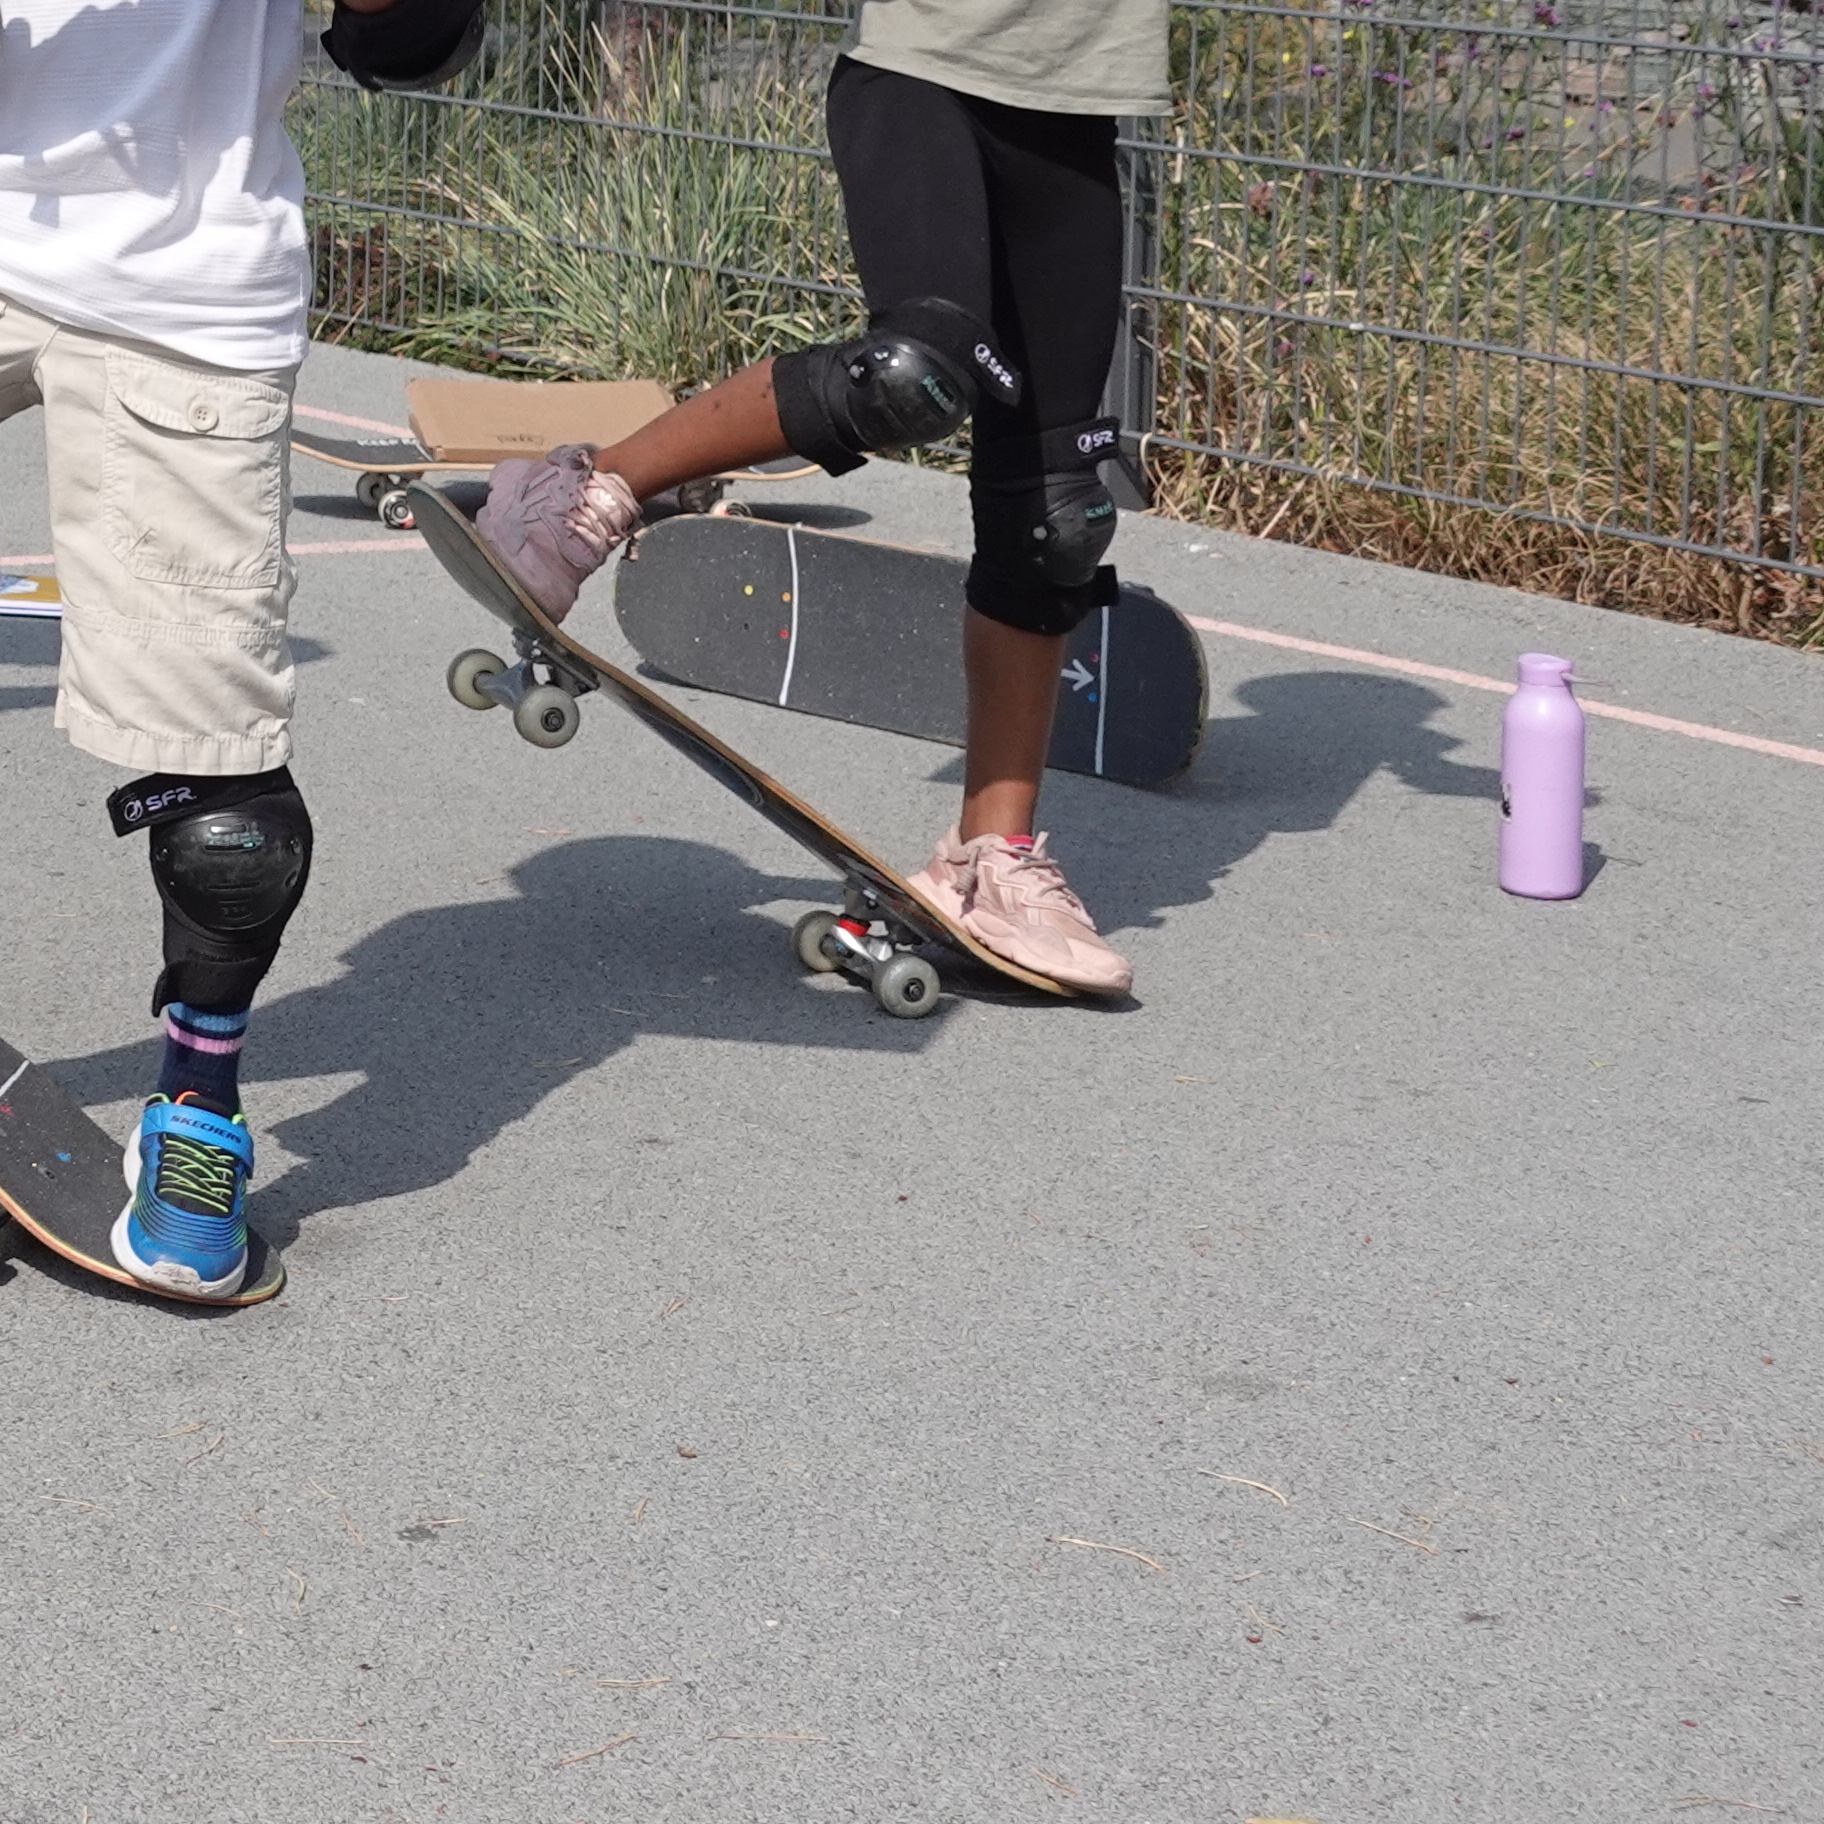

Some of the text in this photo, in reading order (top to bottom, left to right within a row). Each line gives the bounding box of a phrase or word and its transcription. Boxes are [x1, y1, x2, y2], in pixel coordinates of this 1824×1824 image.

[1092, 429, 1116, 448] SFR
[145, 787, 196, 812] SFR
[170, 1115, 242, 1144] SKECHERS
